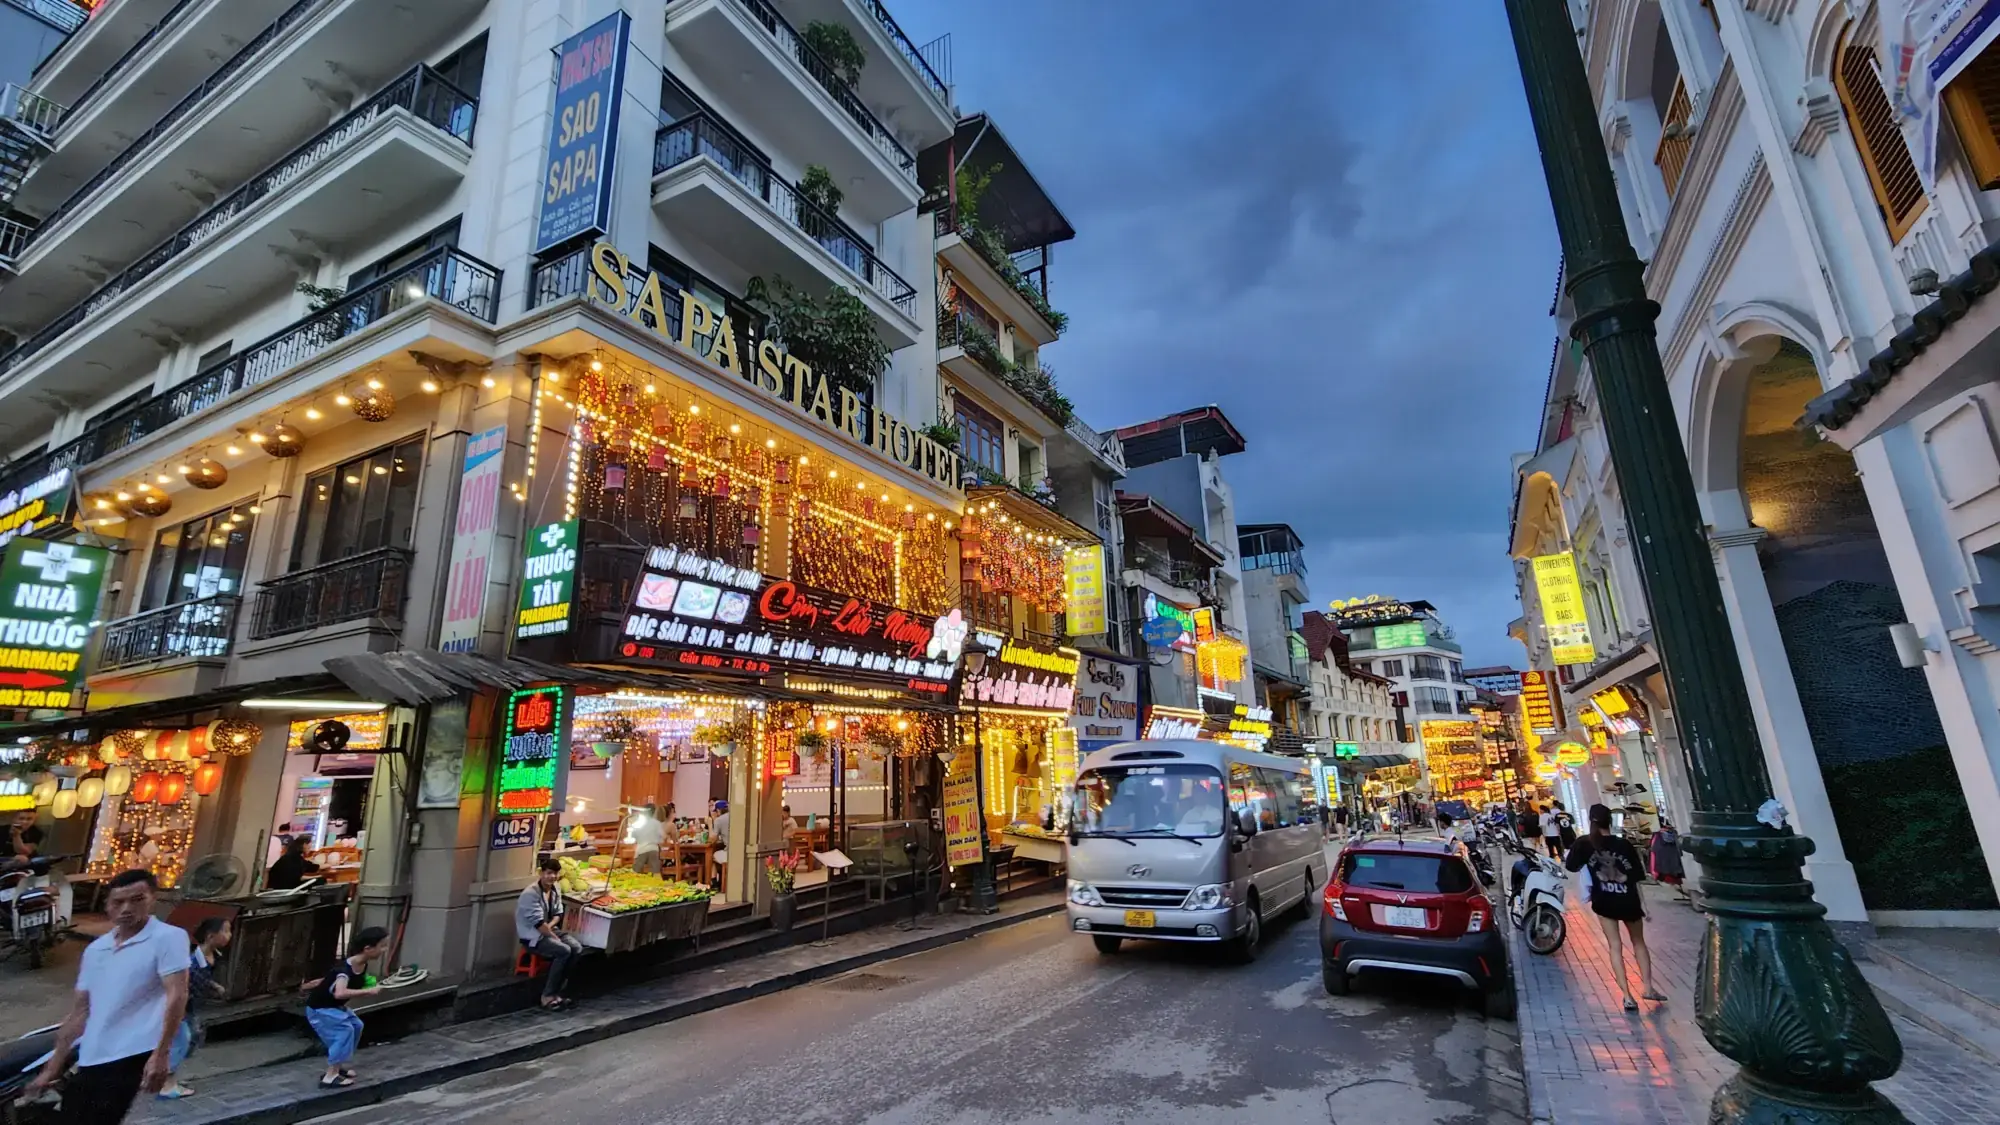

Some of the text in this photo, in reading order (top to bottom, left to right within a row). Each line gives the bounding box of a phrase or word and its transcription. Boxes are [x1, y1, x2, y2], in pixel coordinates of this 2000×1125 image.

[559, 91, 599, 149] SAO
[547, 143, 597, 204] SAPA
[587, 242, 966, 492] SAPA STAR HOTEL
[525, 544, 576, 579] THUỐC
[648, 543, 677, 571] NHÀ
[676, 548, 708, 579] HÀNG
[735, 569, 761, 591] LOAN
[1536, 556, 1571, 571] SOUVENIRS
[14, 581, 77, 612] NHÀ
[532, 579, 563, 607] TÂY
[1541, 574, 1573, 588] CLOTHING
[519, 602, 570, 625] PHARMACY
[1550, 592, 1571, 604] SHOES
[1555, 609, 1573, 621] BAGS
[0, 615, 87, 649] THUỐC
[625, 613, 658, 641] ĐẶC
[657, 617, 688, 643] SẢN
[688, 626, 707, 646] SA
[707, 628, 725, 648] PA
[734, 631, 753, 652] CÁ
[732, 658, 744, 670] TX
[759, 662, 771, 673] Pa
[1072, 688, 1137, 720] Four Seasons
[497, 818, 531, 836] 005
